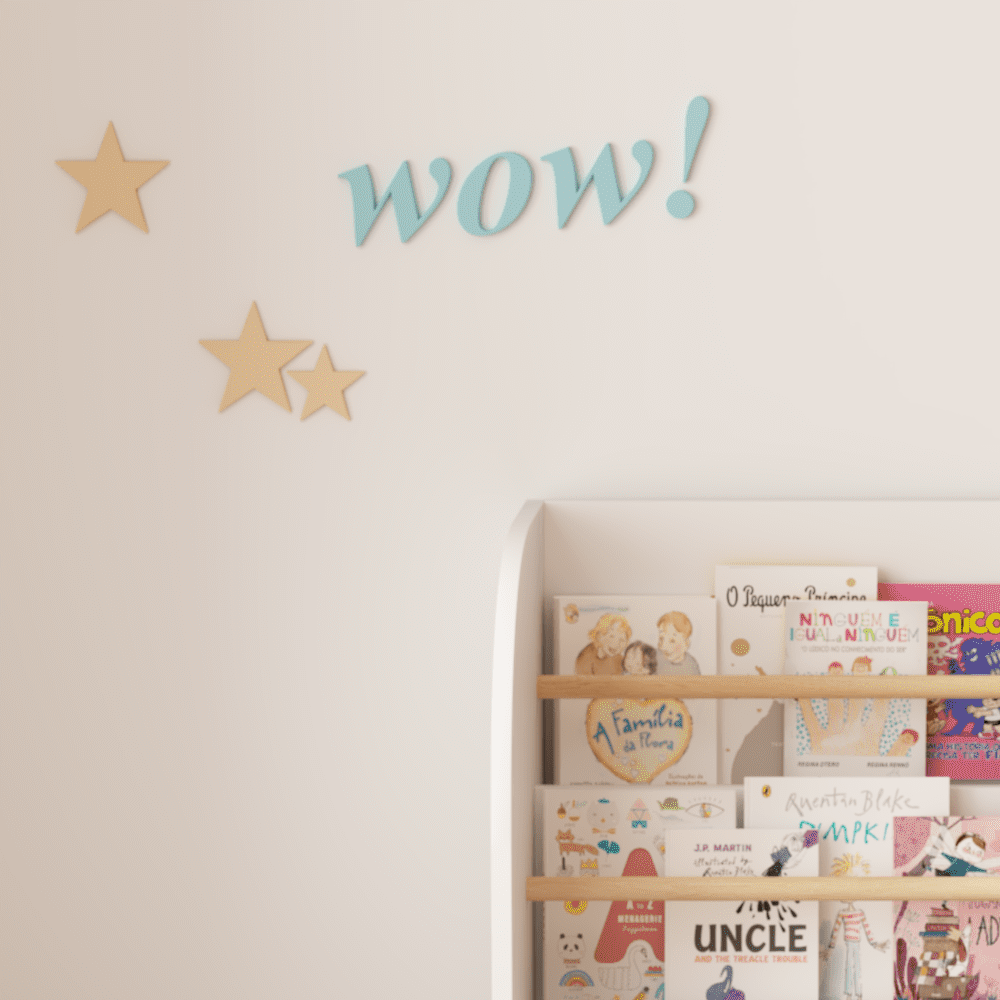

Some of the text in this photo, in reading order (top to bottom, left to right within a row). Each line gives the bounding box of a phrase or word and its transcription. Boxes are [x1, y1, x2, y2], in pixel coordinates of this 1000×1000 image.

[337, 96, 710, 247] wow!
[726, 585, 739, 607] O
[592, 721, 615, 755] A
[854, 788, 920, 816] Blake
[714, 843, 753, 853] MARTIN
[694, 924, 808, 953] UNCLE
[694, 955, 808, 964] AND THE TREACLE TROUBLE
